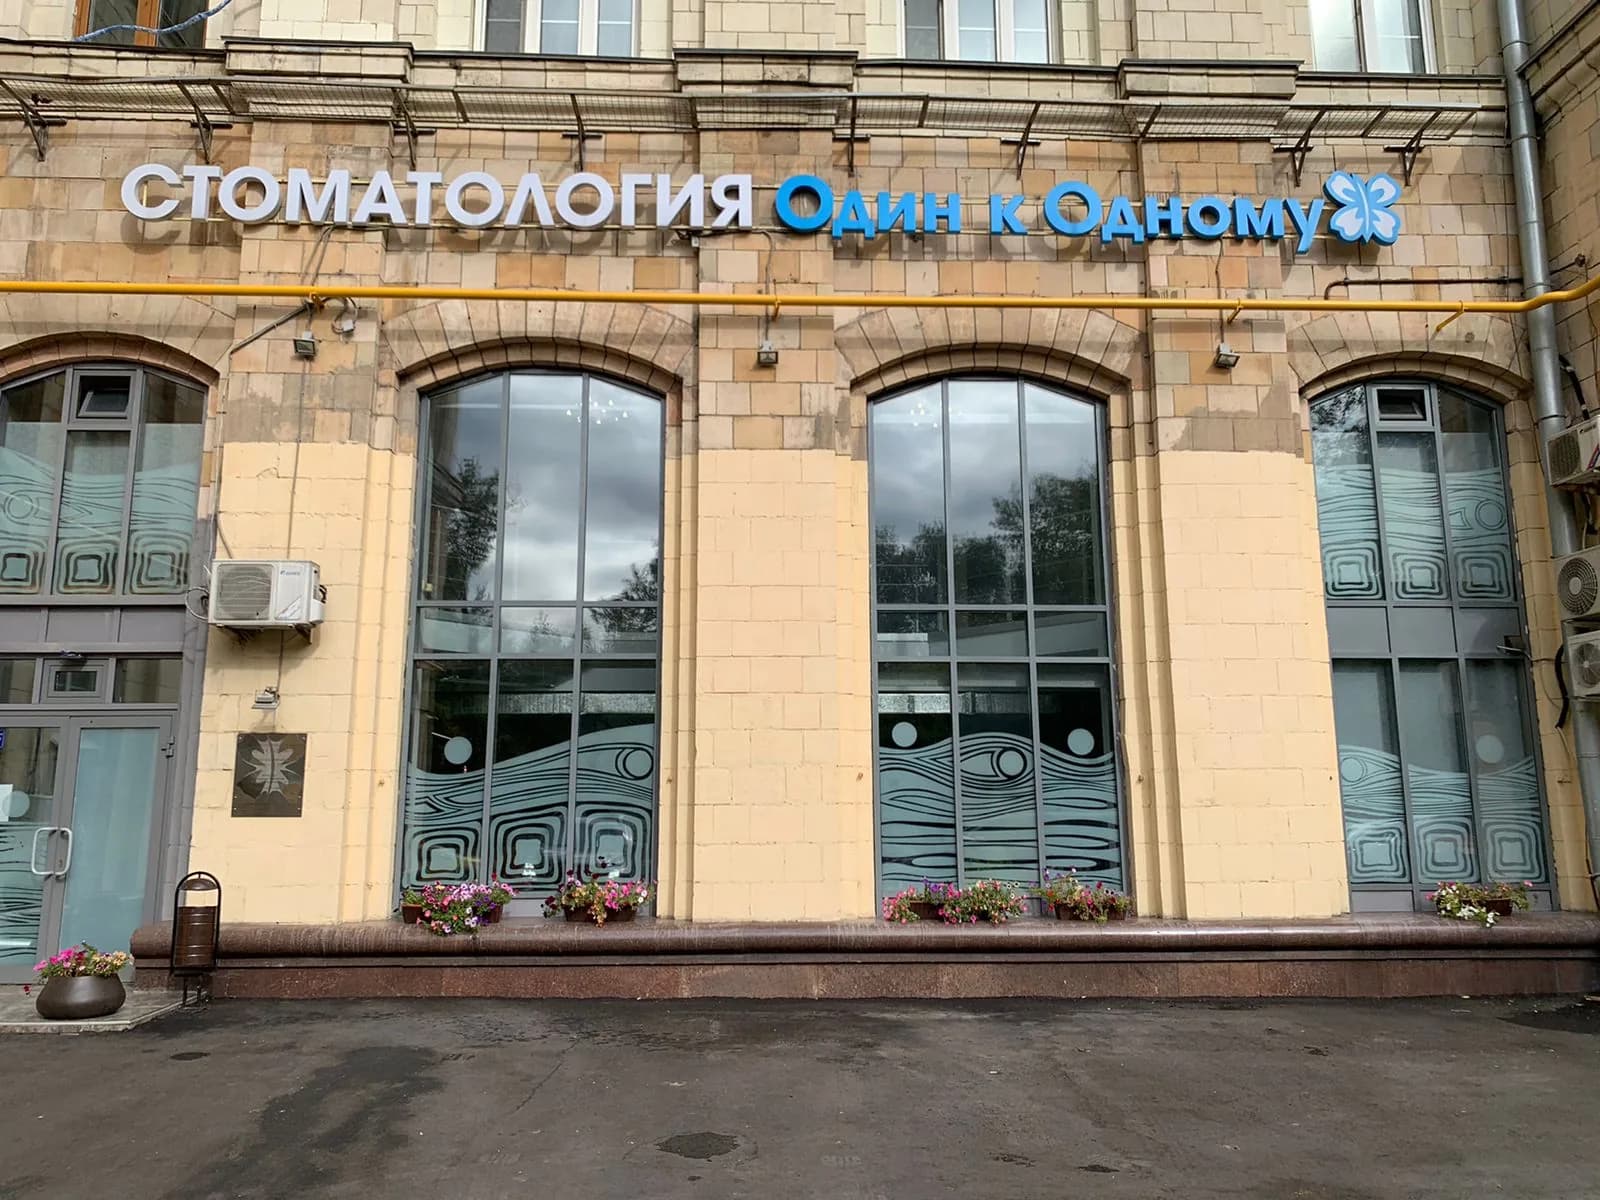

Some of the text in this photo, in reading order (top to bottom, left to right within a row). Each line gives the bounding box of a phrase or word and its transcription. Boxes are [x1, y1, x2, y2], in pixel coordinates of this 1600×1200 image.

[121, 163, 753, 229] СТОМАТОЛОГИЯ
[775, 174, 961, 239] Один
[1043, 180, 1325, 253] Одному
